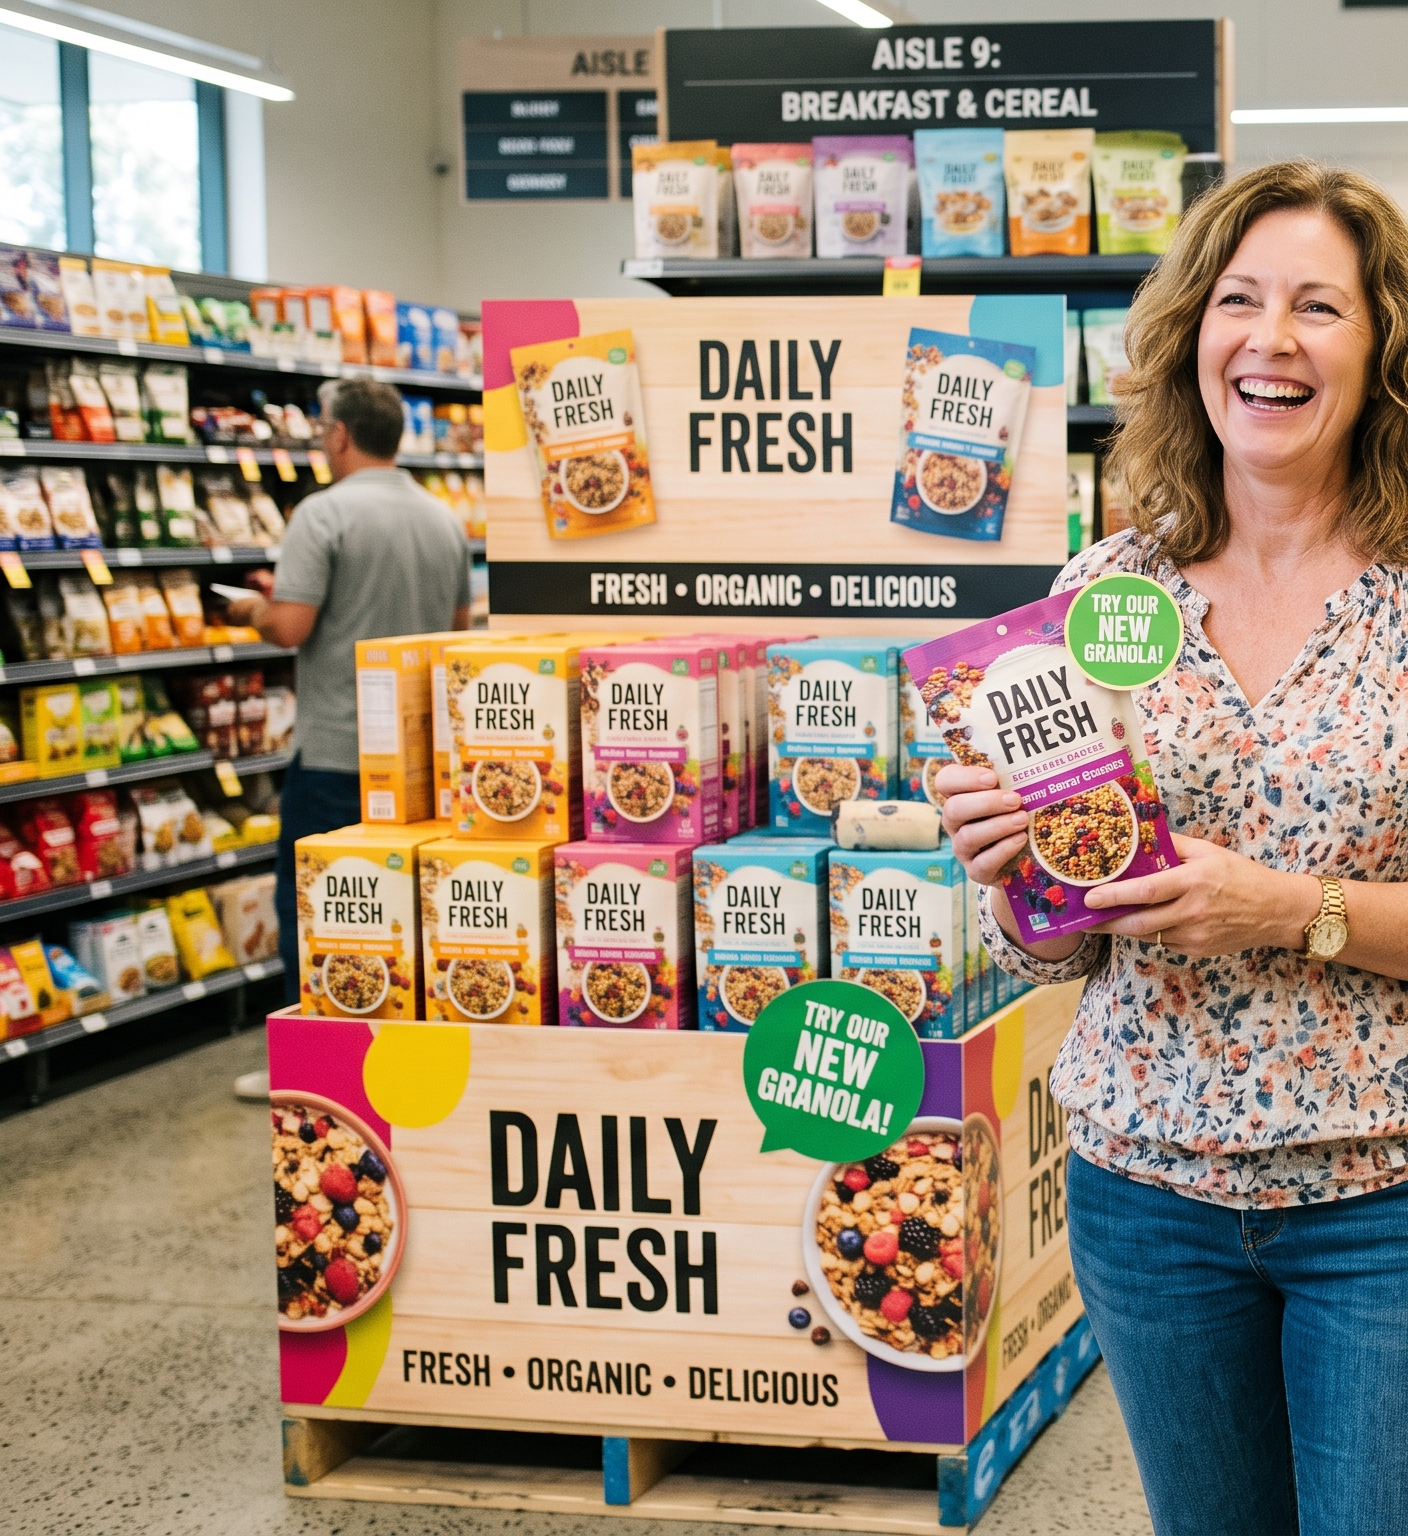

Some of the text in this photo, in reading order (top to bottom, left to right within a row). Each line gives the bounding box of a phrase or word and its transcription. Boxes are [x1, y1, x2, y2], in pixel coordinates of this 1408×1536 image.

[571, 50, 649, 77] AISLE
[872, 37, 1001, 71] AISLE 9:
[781, 87, 1097, 122] BREAKFAST & CEREAL
[699, 339, 842, 402] DAILY
[552, 374, 603, 403] DAILY
[937, 373, 994, 402] DAILY
[553, 398, 614, 428] FRESH
[930, 398, 993, 429] FRESH
[688, 412, 854, 474] FRESH
[590, 573, 957, 609] FRESH ORGANIC DELICIOUS
[1092, 593, 1159, 615] TRY OUR
[1098, 615, 1152, 643] NEW
[1084, 643, 1164, 665] GRANOLA!
[477, 682, 530, 705] DAILY
[611, 683, 664, 706] DAILY
[799, 679, 852, 702] DAILY
[986, 665, 1073, 726] DAILY
[475, 708, 535, 730] FRESH
[608, 708, 668, 731] FRESH
[796, 705, 856, 728] FRESH
[996, 700, 1099, 765] FRESH
[326, 875, 379, 899] DAILY
[451, 879, 504, 902] DAILY
[587, 882, 641, 905] DAILY
[727, 885, 782, 908] DAILY
[862, 887, 917, 911] DAILY
[324, 902, 383, 924] FRESH
[449, 905, 508, 928] FRESH
[584, 909, 645, 931] FRESH
[723, 911, 785, 935] FRESH
[858, 914, 921, 938] FRESH
[804, 1000, 890, 1049] TRY OUR
[794, 1029, 878, 1091] NEW
[758, 1067, 894, 1136] GRANOLA!
[489, 1109, 719, 1216] DAILY
[491, 1220, 719, 1316] FRESH
[1002, 1315, 1029, 1370] FRESH
[402, 1348, 839, 1407] FRESH ORGANIC DELICIOUS
